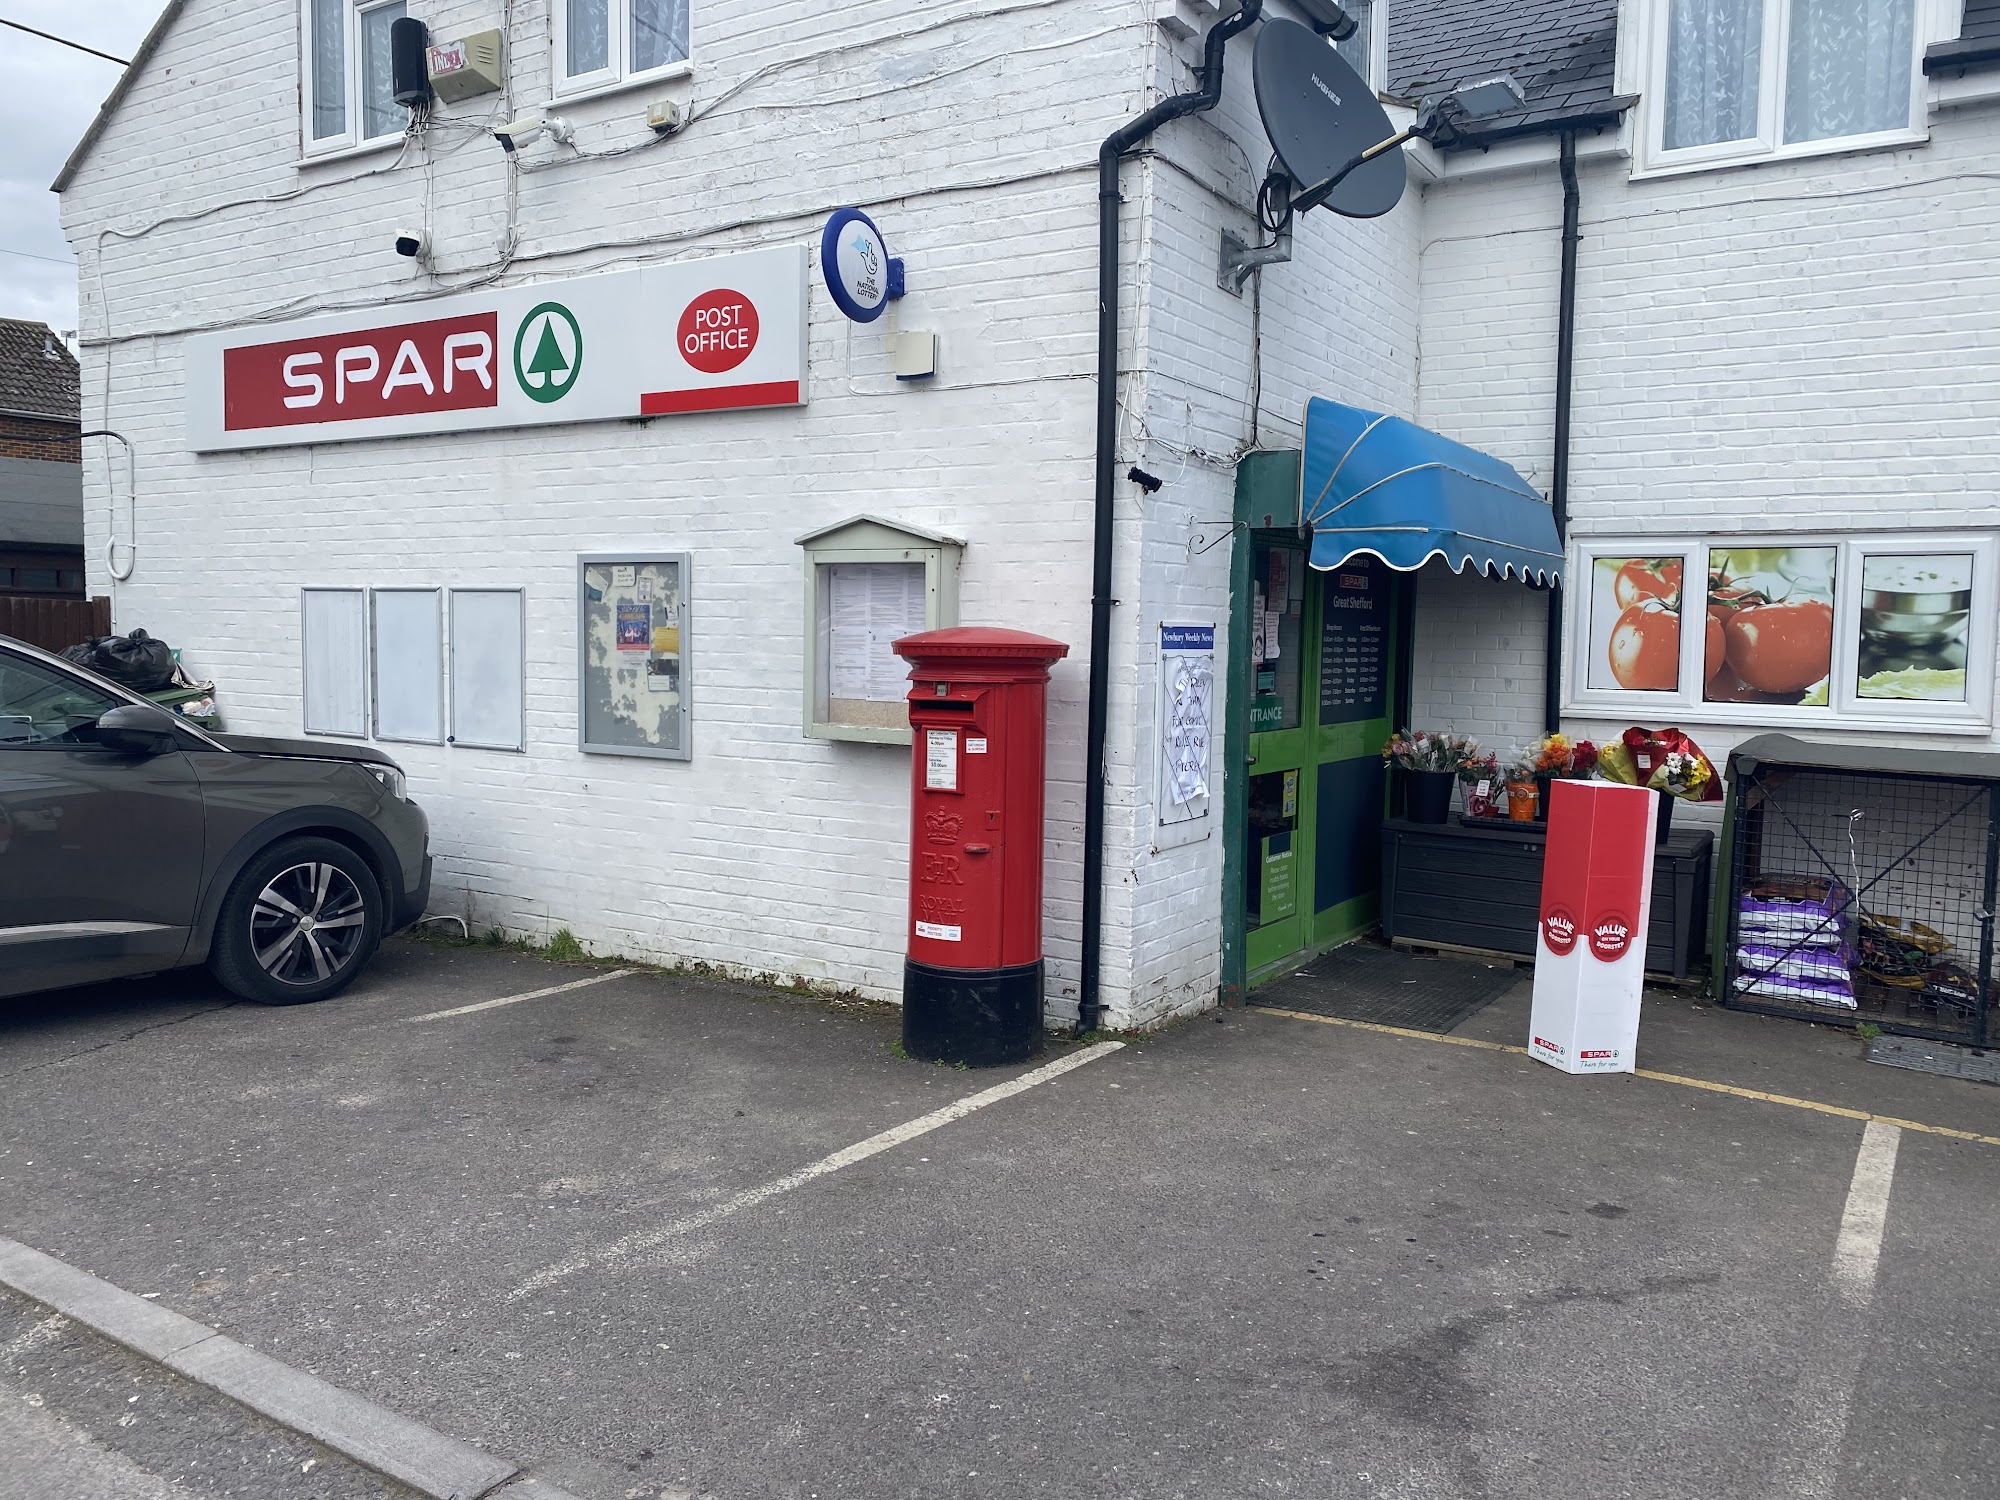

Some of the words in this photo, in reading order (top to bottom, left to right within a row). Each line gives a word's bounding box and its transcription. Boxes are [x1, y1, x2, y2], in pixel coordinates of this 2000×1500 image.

[1311, 73, 1342, 106] HUGHES
[857, 280, 880, 295] NATIONAL
[866, 276, 876, 286] THE
[857, 288, 879, 300] LOTTERY
[696, 304, 742, 329] POST
[684, 327, 748, 354] OFFICE
[283, 330, 493, 409] SPAR
[1344, 577, 1363, 586] SPAR
[1333, 595, 1349, 608] Great
[1350, 596, 1373, 609] Shefford
[1163, 632, 1184, 644] Newbury
[1185, 632, 1201, 644] Weekly
[1201, 632, 1213, 642] News
[1250, 706, 1282, 722] NTRANCE
[1265, 854, 1281, 863] Customer
[1281, 851, 1293, 860] Notice
[920, 894, 966, 912] ROYAL
[922, 908, 960, 926] MAIL
[1547, 916, 1574, 935] VALUE
[1594, 924, 1628, 938] VALUE
[1548, 931, 1571, 944] DOORSTEP
[1596, 941, 1625, 950] DOORSTEP
[1539, 1039, 1559, 1053] SPAR
[1534, 1045, 1546, 1057] There
[1547, 1052, 1555, 1060] for
[1555, 1057, 1565, 1065] you
[1580, 1060, 1597, 1068] There
[1597, 1060, 1607, 1068] for
